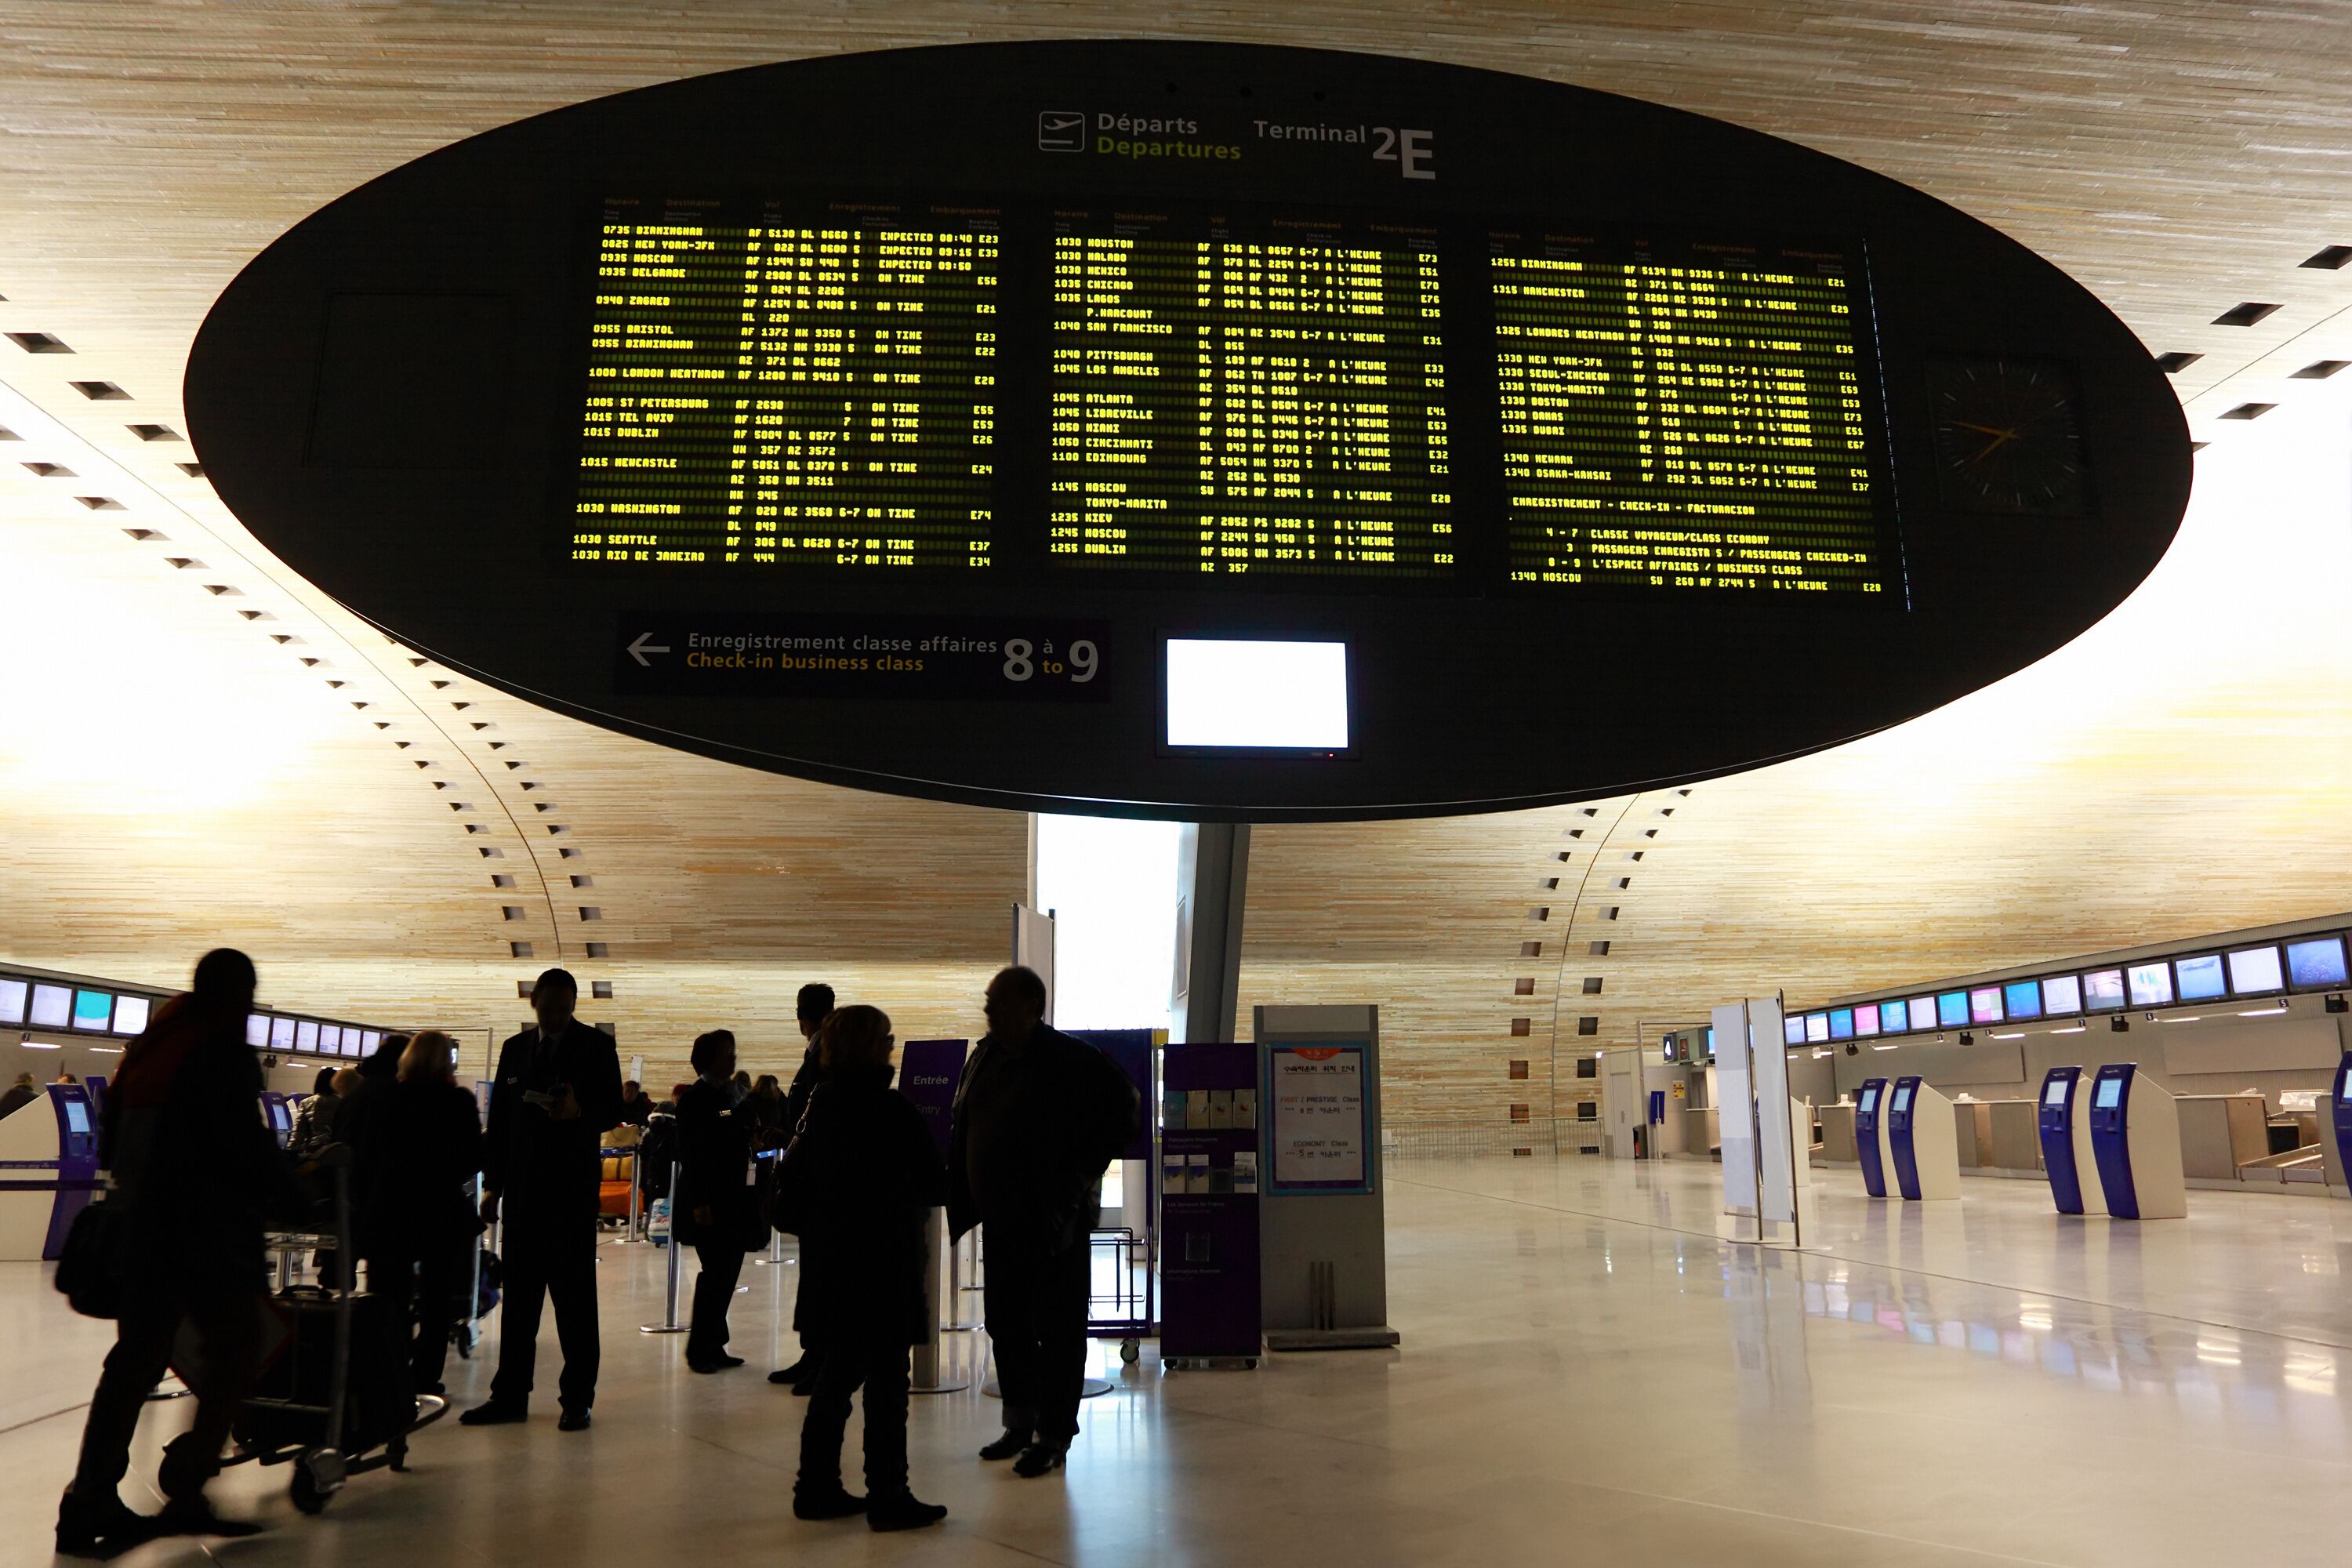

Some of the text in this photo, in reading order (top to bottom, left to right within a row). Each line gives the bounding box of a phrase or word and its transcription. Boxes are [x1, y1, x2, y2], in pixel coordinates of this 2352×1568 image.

[1098, 113, 1198, 136] Départs
[1254, 120, 1366, 143] Terminal
[1098, 136, 1242, 159] Departures
[636, 225, 703, 236] BIRMINGHAM
[634, 239, 998, 258] NEW YORK-JFK E39
[1087, 238, 1438, 263] HOUSTON E73
[633, 253, 674, 263] MOSCOW
[1087, 252, 1127, 263] MALABO
[1490, 257, 1583, 271] 1255 BIRMINGHAM
[598, 267, 997, 285] 0935 BELGRADE E56
[1087, 265, 1127, 276] MEXICO
[1054, 278, 1134, 290] 1035 CHICAGO
[1493, 284, 1585, 298] 1315 MANCHESTER
[629, 296, 996, 314] ZAGREB E21
[1087, 293, 1440, 318] LAGOS E35
[1086, 307, 1152, 319] P.HARCOURT
[593, 324, 674, 335] 0955 BRISTOL
[1086, 321, 1442, 345] SAN FRANCISCO E31
[1495, 325, 1625, 341] 1325 LONDRES HEATHROW
[625, 339, 694, 350] BIRMINGHAM
[1086, 350, 1153, 361] PITTSBURGH
[622, 368, 725, 379] LONDON HEATHROW
[1086, 364, 1160, 376] LOS ANGELES
[1527, 354, 1857, 381] NEW YORK-JFK E61
[1528, 368, 1610, 381] SEOUL-INCHEON
[1530, 382, 1605, 395] TOKYO-NARITA
[1085, 393, 1134, 405] ATLANTA
[1530, 396, 1570, 407] BOSTON
[619, 397, 994, 415] ST PETERSBURG E55
[584, 412, 674, 423] 1015 TEL AVIV
[1085, 408, 1153, 420] LIBREVILLE
[1531, 410, 1564, 422] DAMAS
[616, 427, 659, 437] DUBLIN
[1085, 423, 1120, 434] MIAMI
[1501, 423, 1864, 449] 1335 DUBAI E67
[1085, 437, 1153, 449] CINCINNATI
[614, 457, 677, 468] NEWCASTLE
[1534, 454, 1573, 465] NEWARK
[1536, 468, 1869, 492] OSAKA-KANSAI E37
[1051, 481, 1127, 493] 1145 MOSCOU
[1085, 497, 1167, 510] TOKYO-NARITA
[1512, 496, 1755, 515] ENREGISTREMENT CHECK-IN FACTURACION
[610, 503, 991, 520] WASHINGTON E74
[1051, 512, 1452, 533] 1235 KIEV E56
[608, 534, 657, 545] SEATTLE
[1084, 528, 1127, 539] MOSCOU
[1590, 528, 1629, 539] CLASSE
[1726, 533, 1769, 545] ECONOMY
[1050, 543, 1127, 554] 1255 DUBLIN
[1591, 543, 1867, 563] PASSAGERS PASSENGERS CHECKED-IN
[606, 550, 628, 561] RIO
[655, 550, 705, 561] JANEIRO
[1592, 558, 1803, 575] L'ESPACE AFFAIRES BUSINESS CLASS
[1542, 572, 1581, 583] MOSCOU
[688, 633, 998, 653] Enregistrement classe affaires
[687, 652, 924, 672] Check-in business class
[1002, 638, 1098, 684] 8 à 9
[1042, 659, 1063, 675] to
[913, 1075, 949, 1085] Entrée
